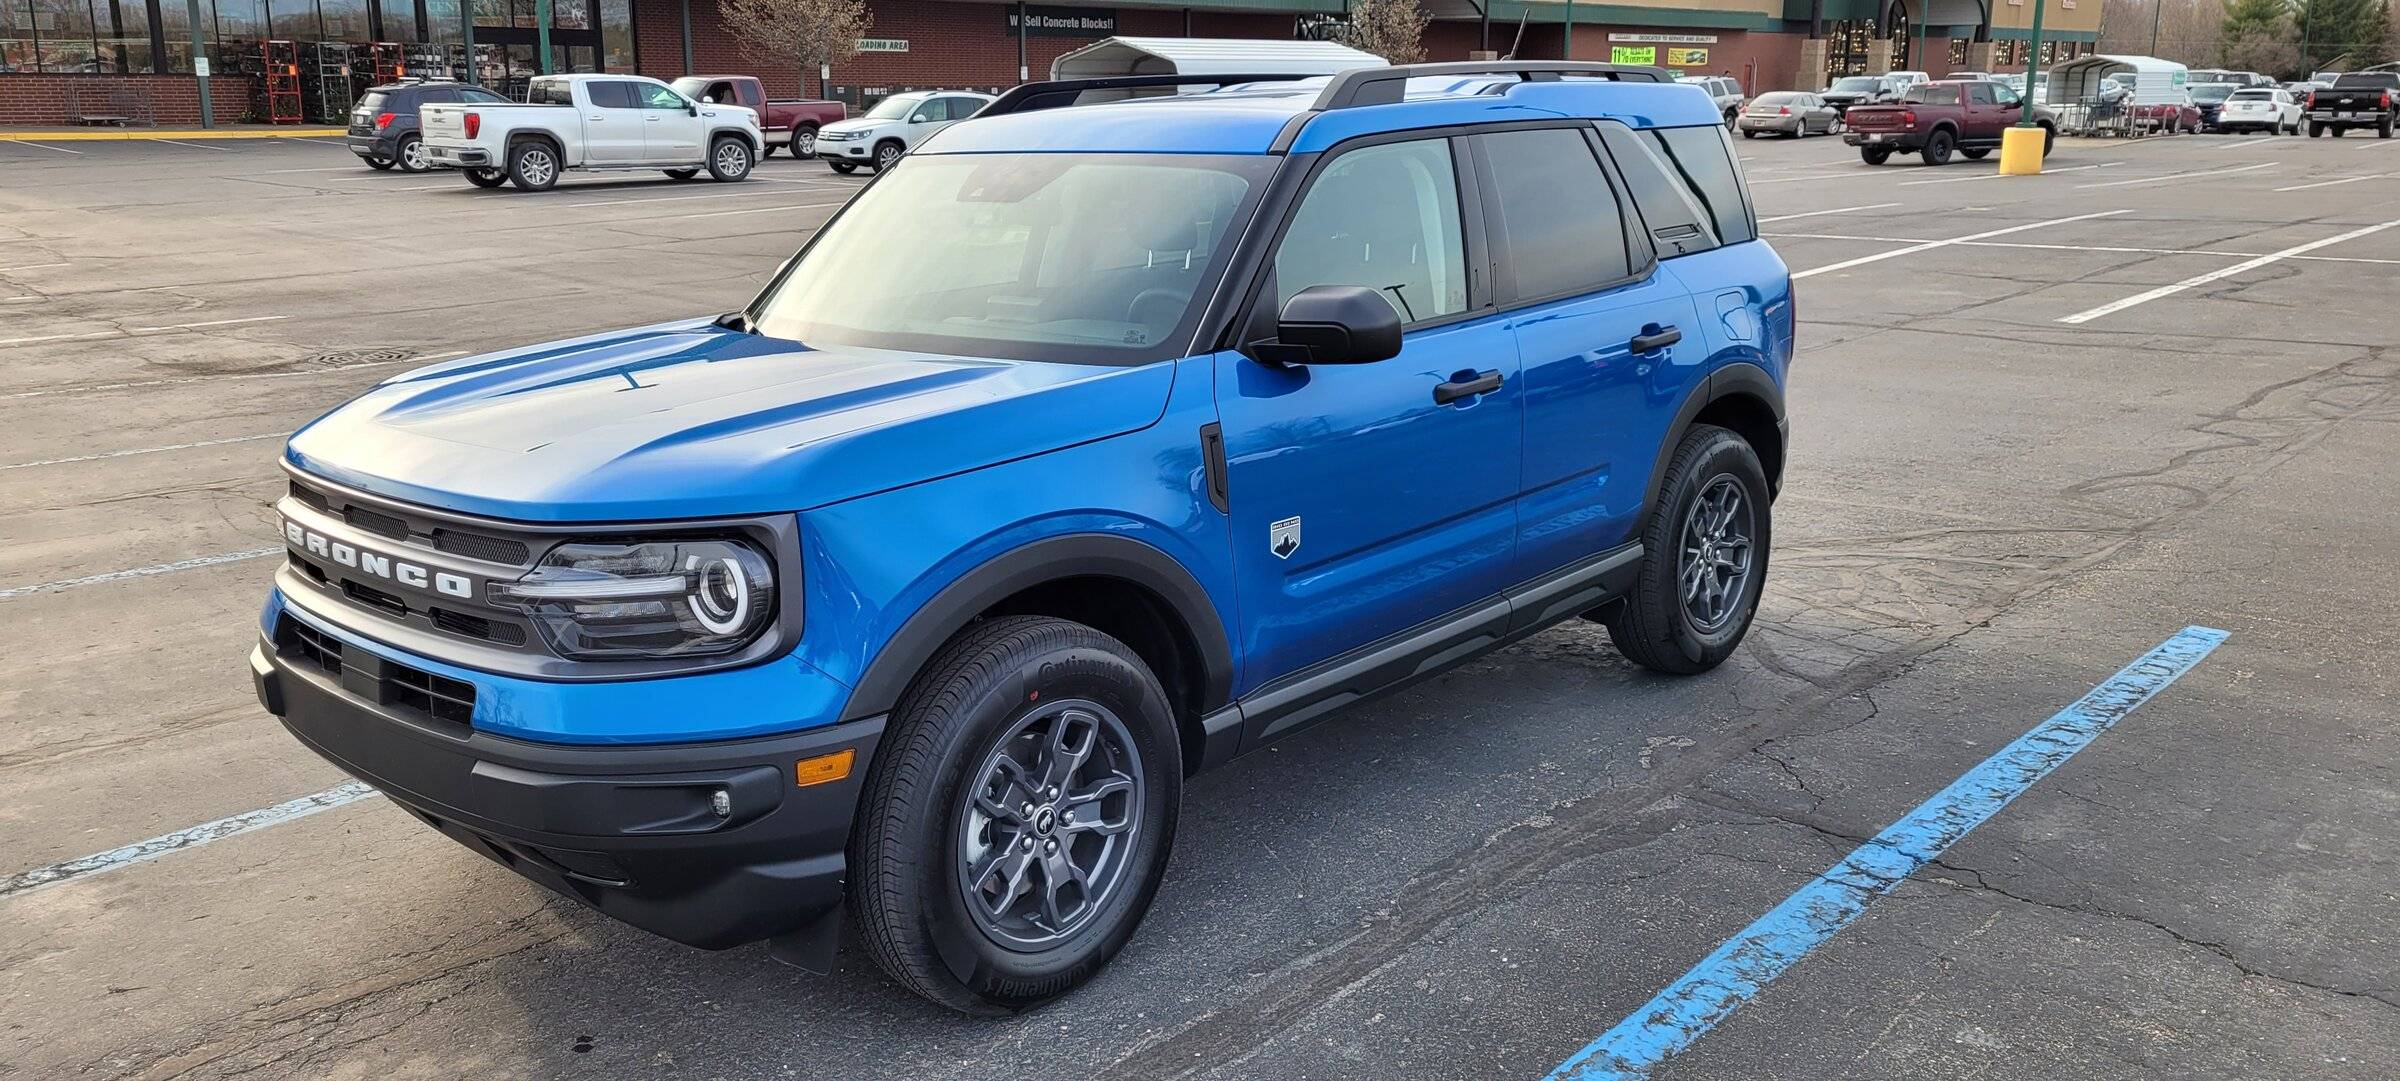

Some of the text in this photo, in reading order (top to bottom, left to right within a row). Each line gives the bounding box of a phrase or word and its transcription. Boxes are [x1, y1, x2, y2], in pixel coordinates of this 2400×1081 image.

[1025, 15, 1041, 26] Sell
[1043, 16, 1079, 29] Concrete
[1081, 18, 1114, 29] Blocks!!
[889, 42, 908, 50] AREA
[286, 521, 472, 599] BRONCO
